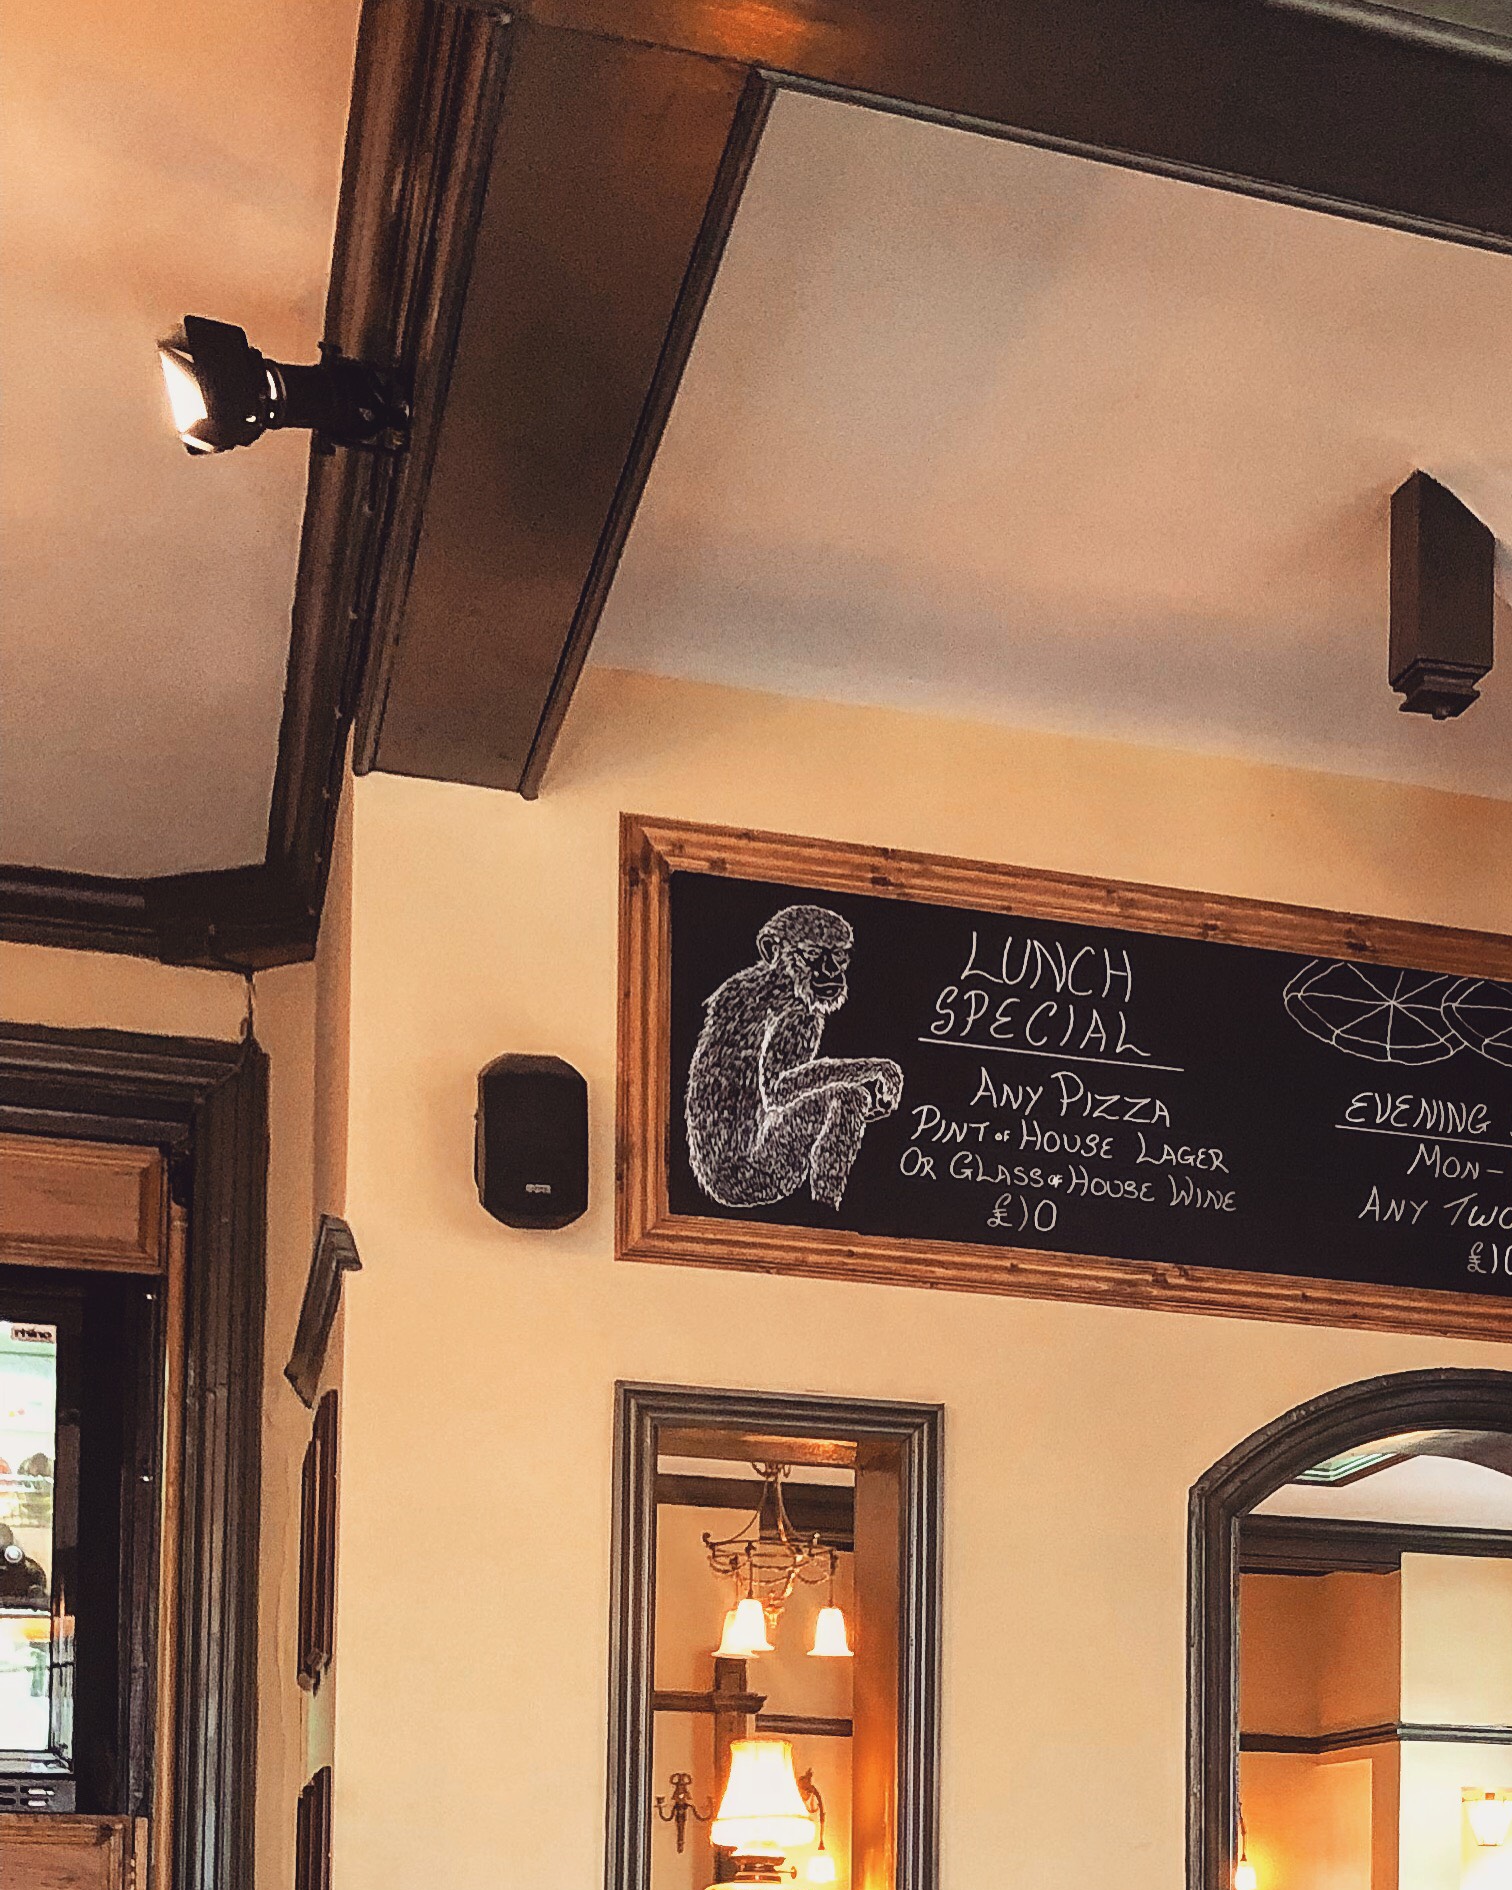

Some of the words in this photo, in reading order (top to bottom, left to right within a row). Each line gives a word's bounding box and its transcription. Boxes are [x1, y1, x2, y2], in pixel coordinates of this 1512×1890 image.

[961, 931, 1131, 1002] LUNCH
[931, 986, 1151, 1056] SPECIAL
[970, 1067, 1043, 1115] ANY
[1051, 1071, 1170, 1127] PIZZA
[1345, 1092, 1491, 1134] EVENING
[911, 1105, 990, 1143] PINT
[1019, 1119, 1113, 1158] HOUSE
[1136, 1132, 1229, 1173] LAGER
[950, 1151, 1044, 1187] GLASS
[1067, 1165, 1154, 1201] HOUSE
[1168, 1175, 1236, 1211] WINE
[1358, 1186, 1428, 1224] ANY
[987, 1193, 1057, 1231] £10
